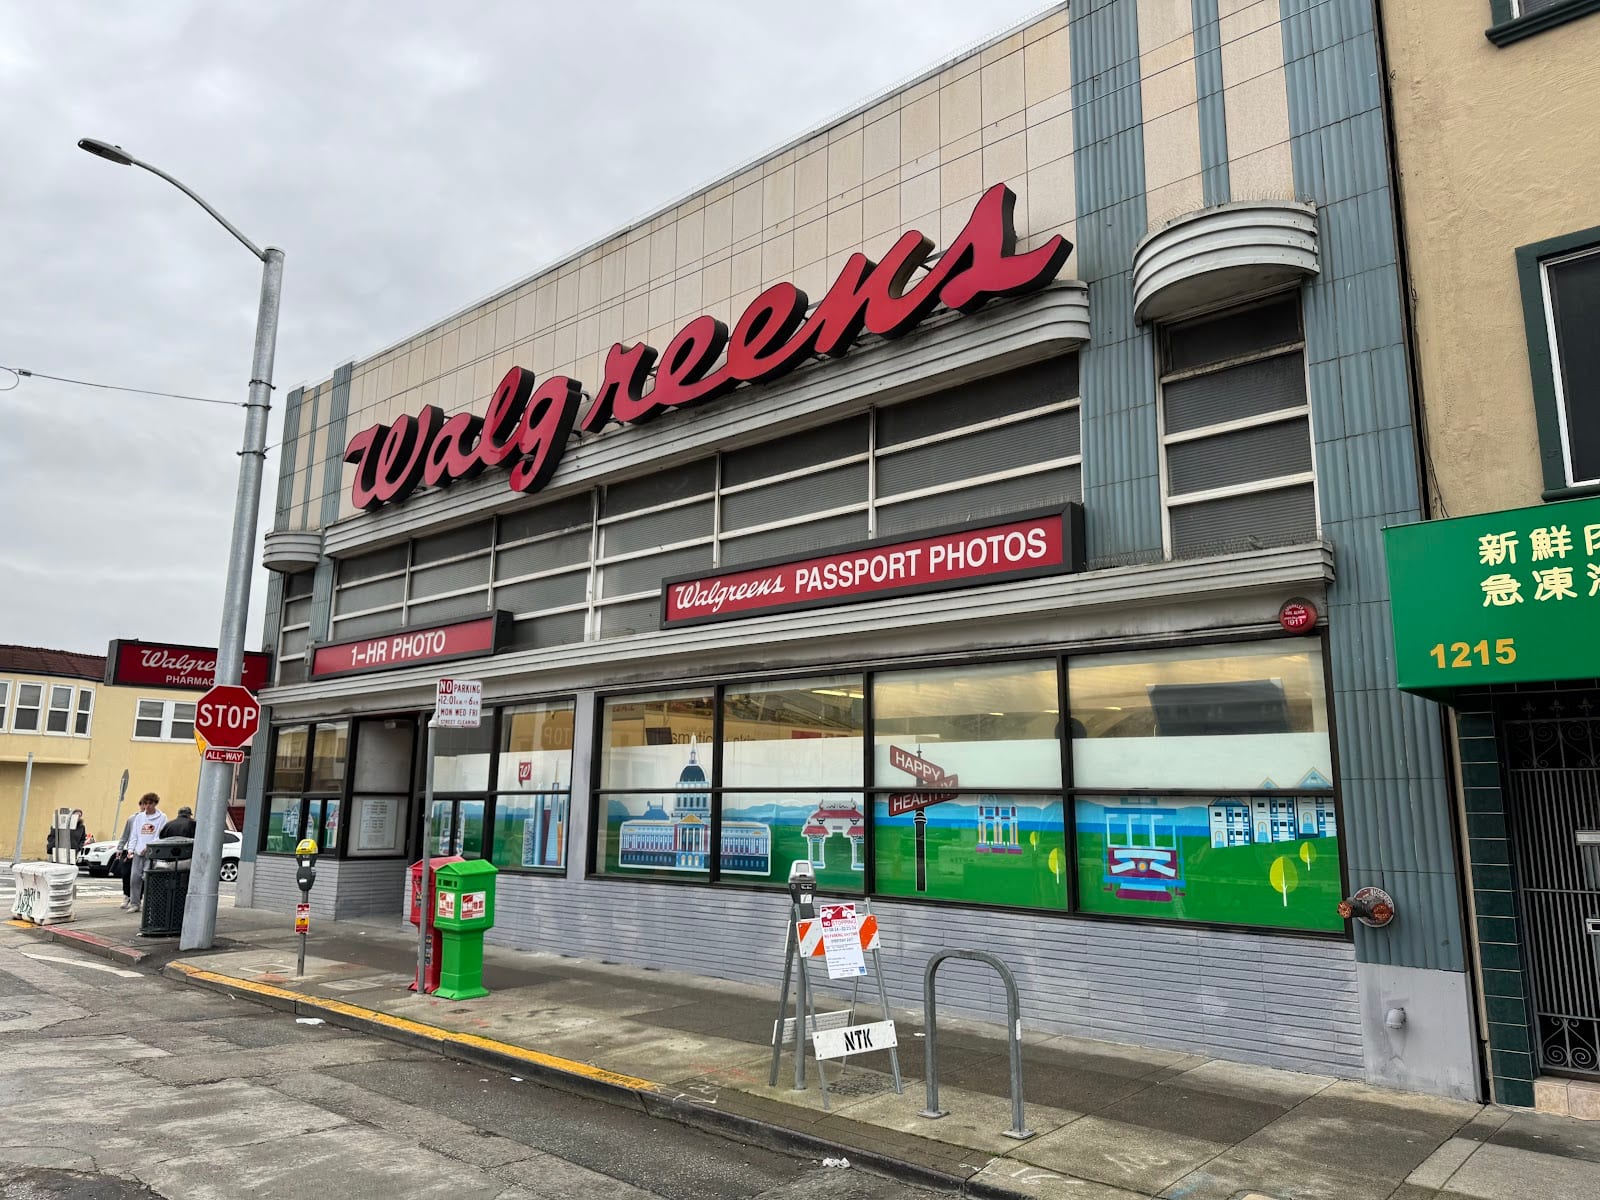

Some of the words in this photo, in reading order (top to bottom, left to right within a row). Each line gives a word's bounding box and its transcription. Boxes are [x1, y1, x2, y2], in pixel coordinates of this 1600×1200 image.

[343, 182, 1073, 511] Walgreens
[675, 574, 785, 613] Walgreens
[795, 549, 921, 594] PASSPORT
[929, 527, 1047, 573] PHOTOS
[351, 641, 386, 666] 1-HR
[391, 630, 446, 660] PHOTO
[1430, 638, 1516, 668] 1215
[166, 675, 216, 686] PHARMAC
[440, 680, 452, 693] NO
[454, 684, 480, 693] PARKING
[199, 703, 256, 729] STOP
[206, 751, 242, 761] ALL-WAY
[896, 752, 940, 781] HAPPY
[843, 1028, 873, 1051] NTK
